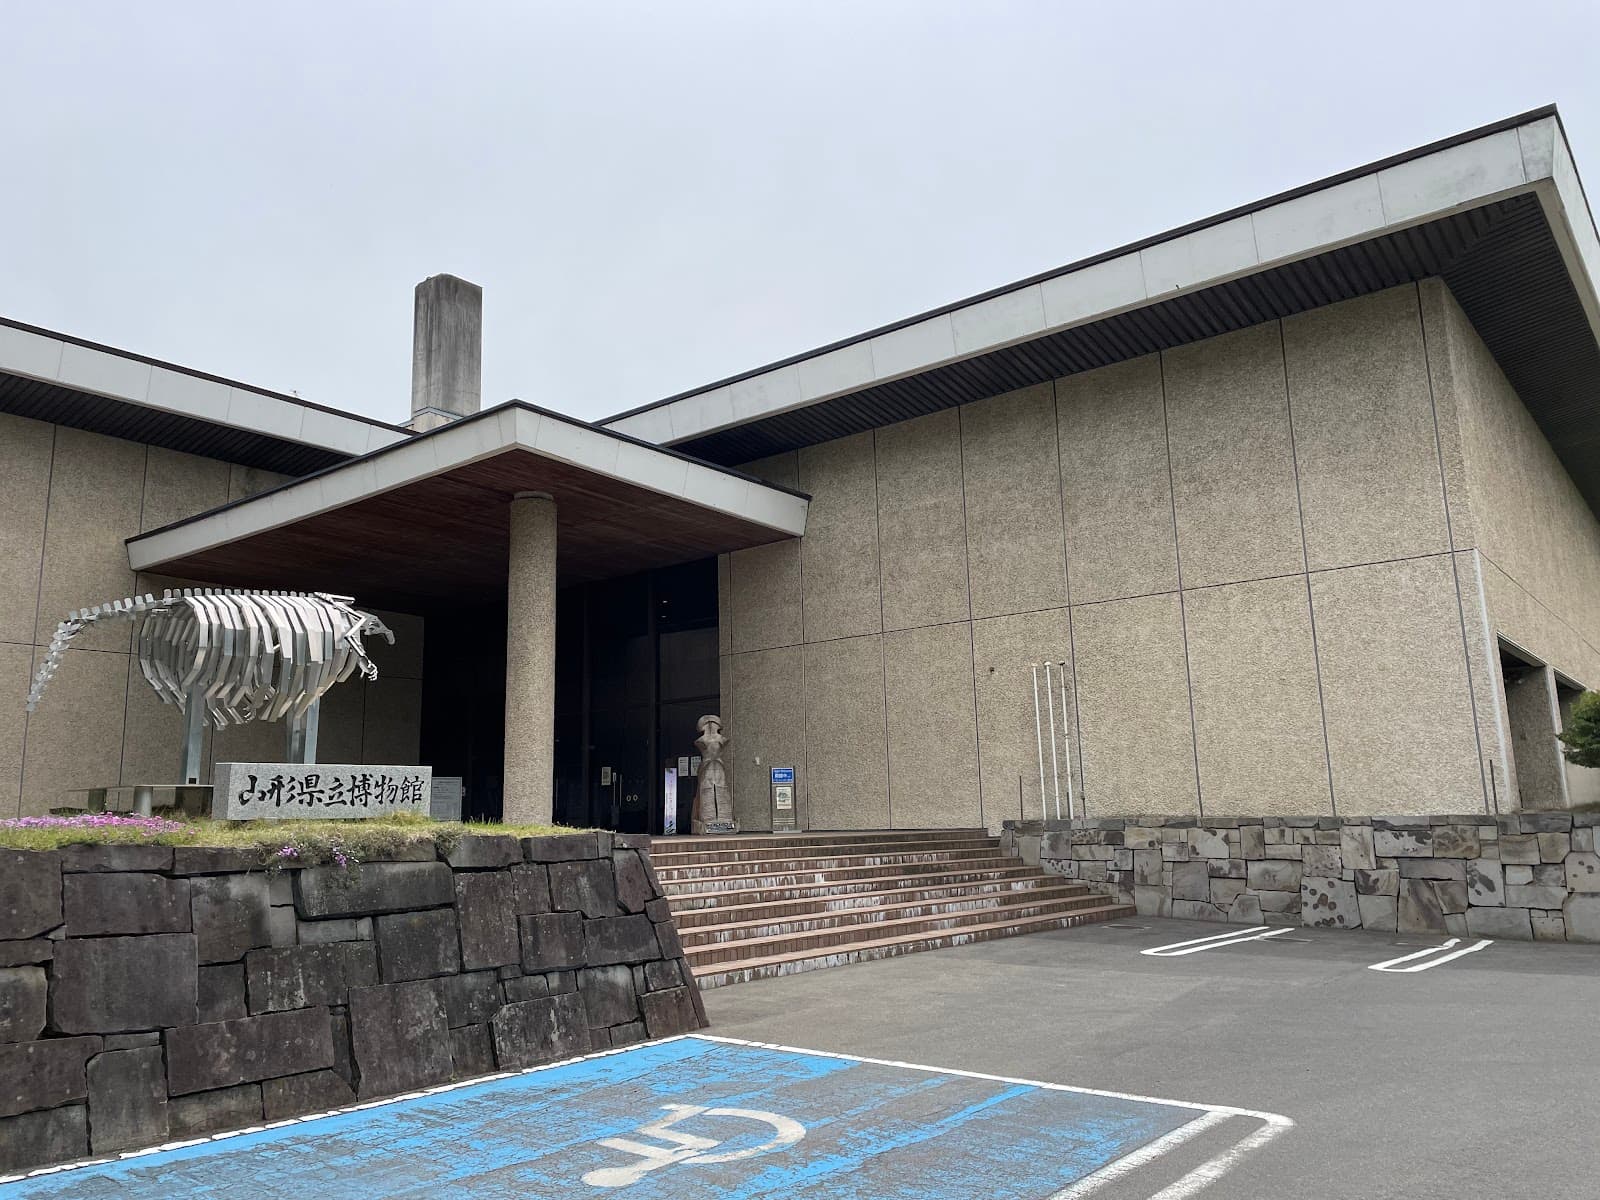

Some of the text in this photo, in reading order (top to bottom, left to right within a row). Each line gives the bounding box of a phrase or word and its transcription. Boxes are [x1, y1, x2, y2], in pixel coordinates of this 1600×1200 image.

[239, 774, 425, 808] 山形県立博物館
